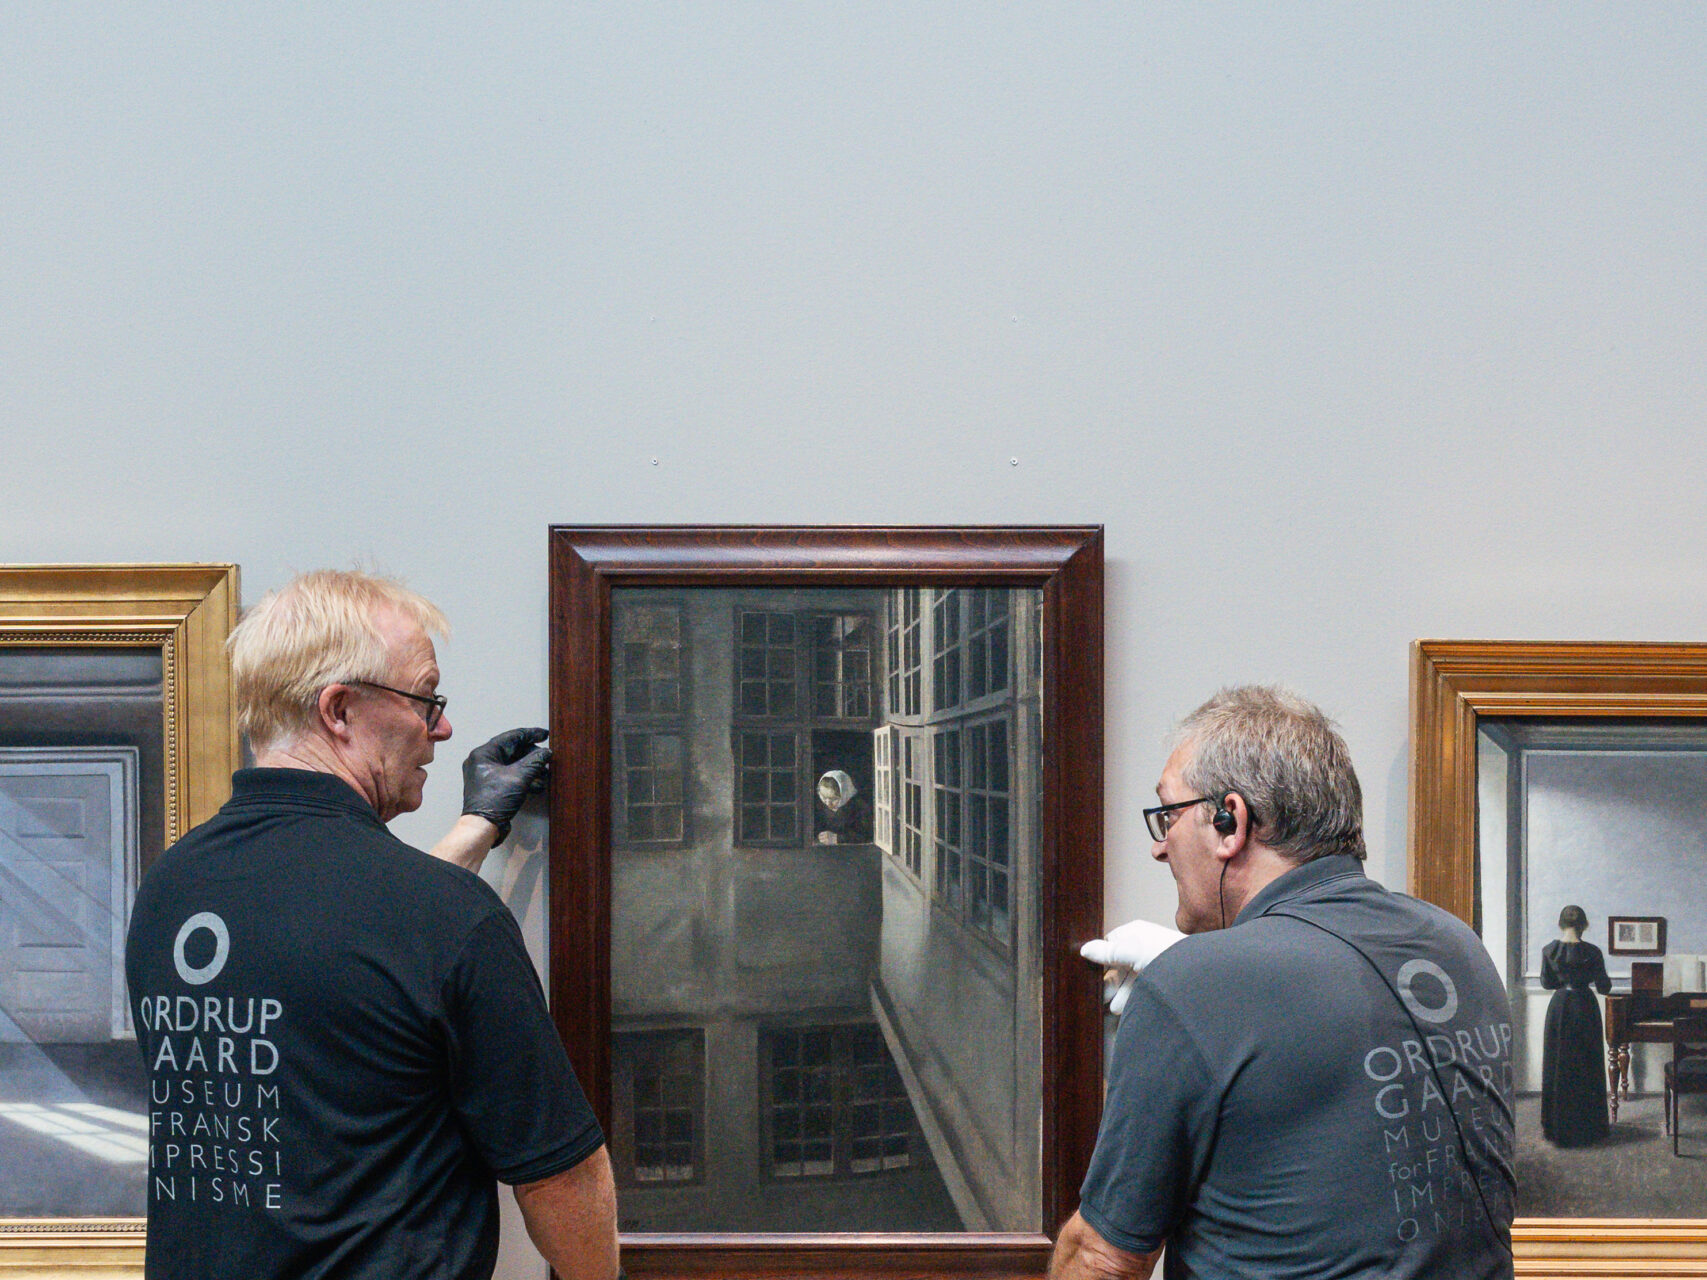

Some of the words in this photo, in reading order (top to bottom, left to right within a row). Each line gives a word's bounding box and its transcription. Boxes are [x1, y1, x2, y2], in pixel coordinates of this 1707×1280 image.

[141, 996, 283, 1034] ORDRUP
[153, 1035, 279, 1075] AARD
[1364, 1023, 1512, 1081] ORDRUP
[152, 1080, 279, 1109] USEUM
[1375, 1061, 1512, 1119] GAARD
[152, 1112, 280, 1142] FRANSK
[1384, 1107, 1503, 1152] MUSEU
[150, 1145, 281, 1176] PRESSI
[1388, 1162, 1422, 1182] for
[156, 1176, 281, 1209] NISME
